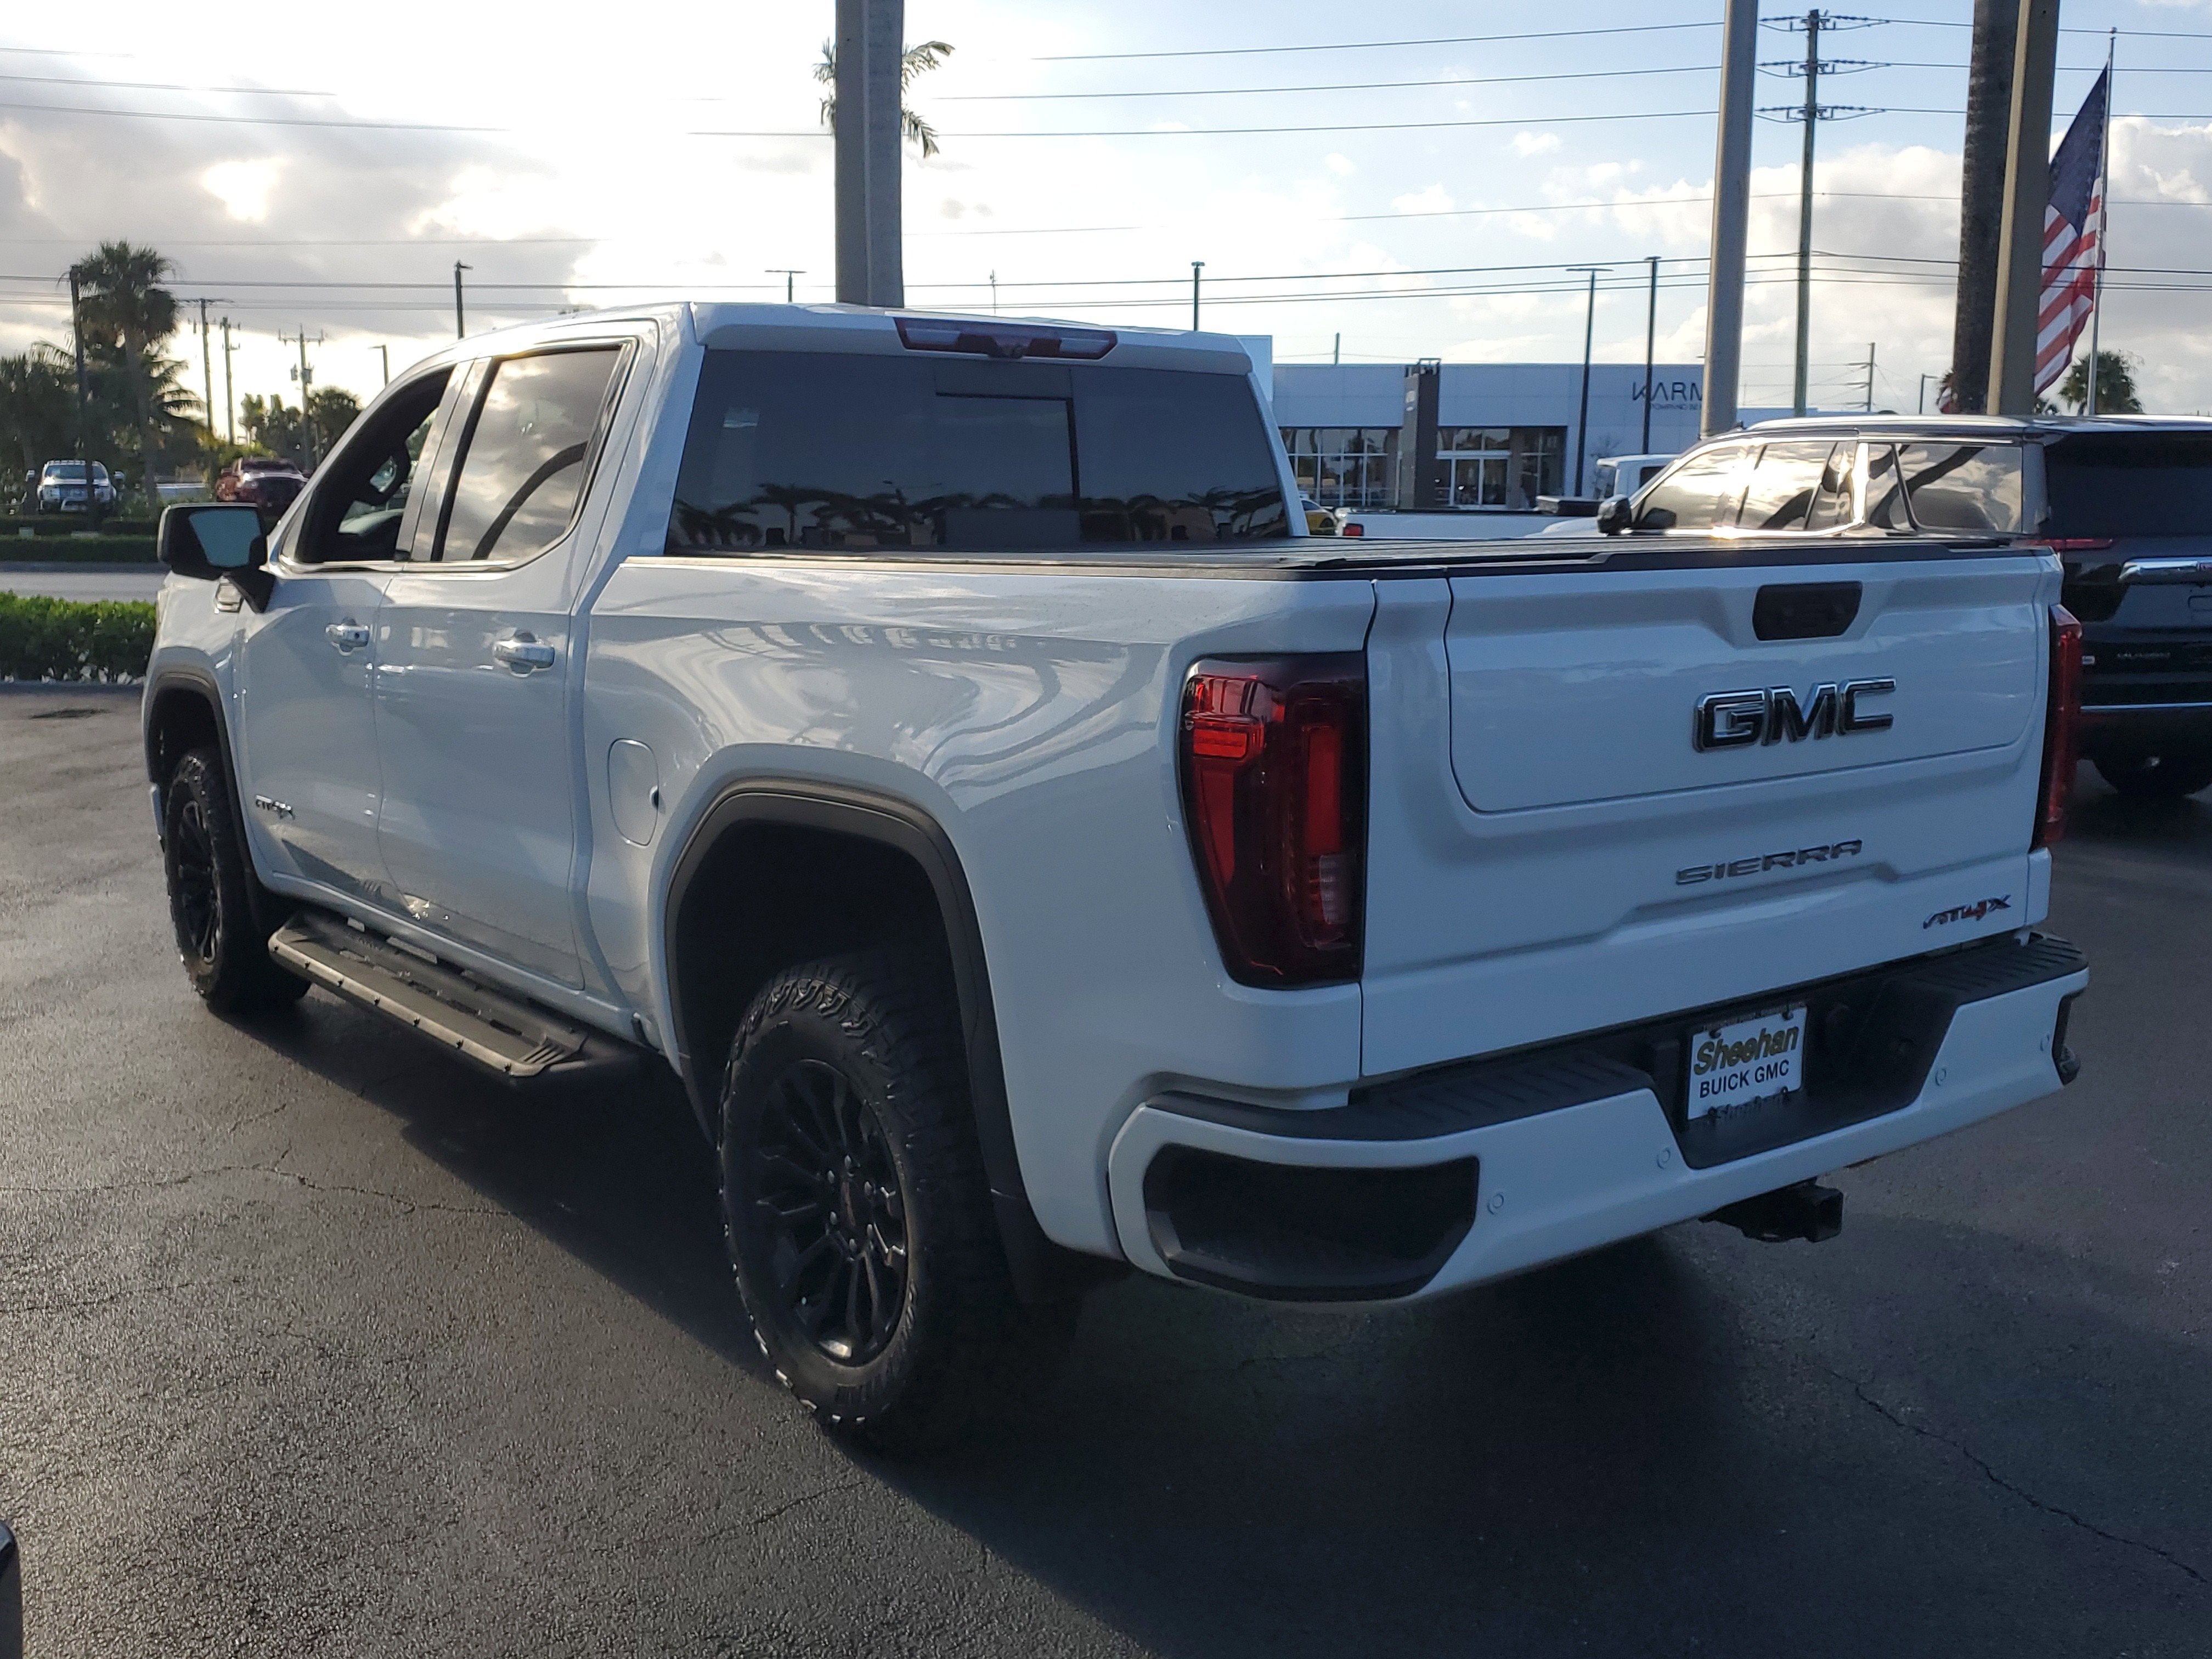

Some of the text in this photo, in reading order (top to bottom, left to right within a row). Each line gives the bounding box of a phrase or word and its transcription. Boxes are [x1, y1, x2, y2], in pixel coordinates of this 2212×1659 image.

[1693, 675, 1896, 752] GMC
[1675, 839, 1863, 885] SIERRA
[1922, 894, 2012, 929] AT4X
[1694, 1026, 1799, 1075] Sheehan
[1700, 1059, 1790, 1098] BUICK GMC
